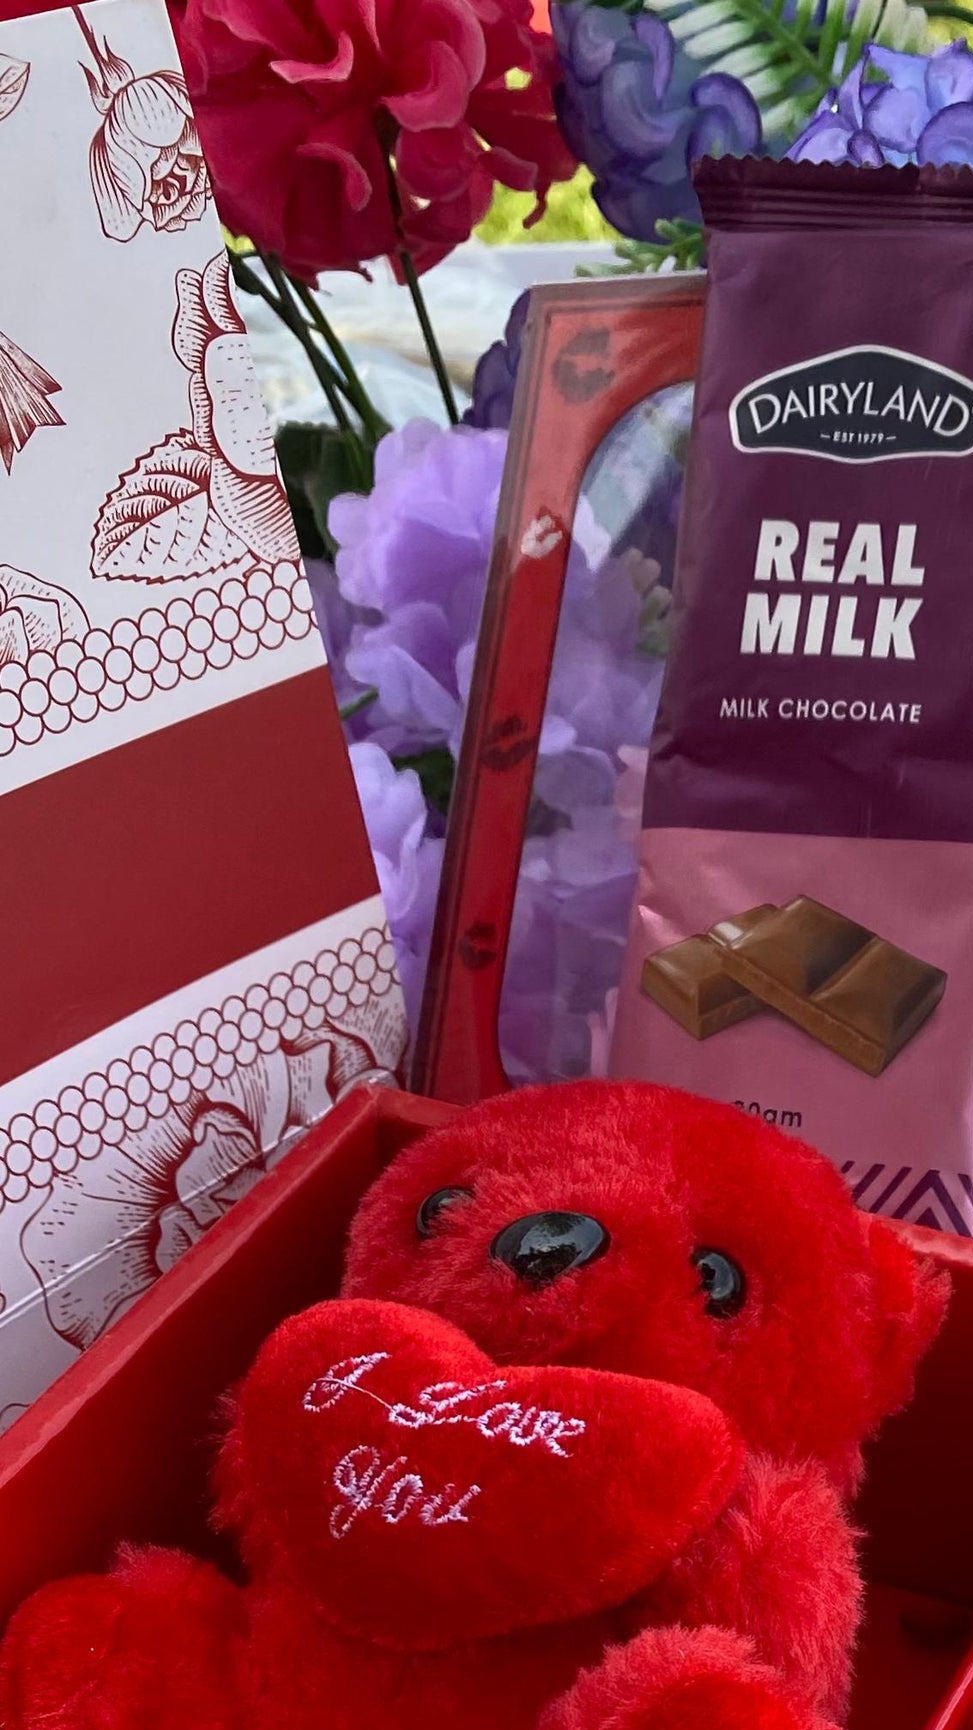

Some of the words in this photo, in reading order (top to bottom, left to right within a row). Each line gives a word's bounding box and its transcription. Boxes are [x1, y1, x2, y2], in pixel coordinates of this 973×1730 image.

[833, 431, 854, 442] EST
[857, 432, 884, 444] 1979
[754, 519, 925, 586] REAL
[740, 592, 923, 660] MILK
[719, 697, 770, 720] MILK
[778, 698, 922, 724] CHOCOLATE
[734, 1100, 802, 1127] 0gm
[388, 1380, 586, 1458] Love
[329, 1445, 481, 1539] You
